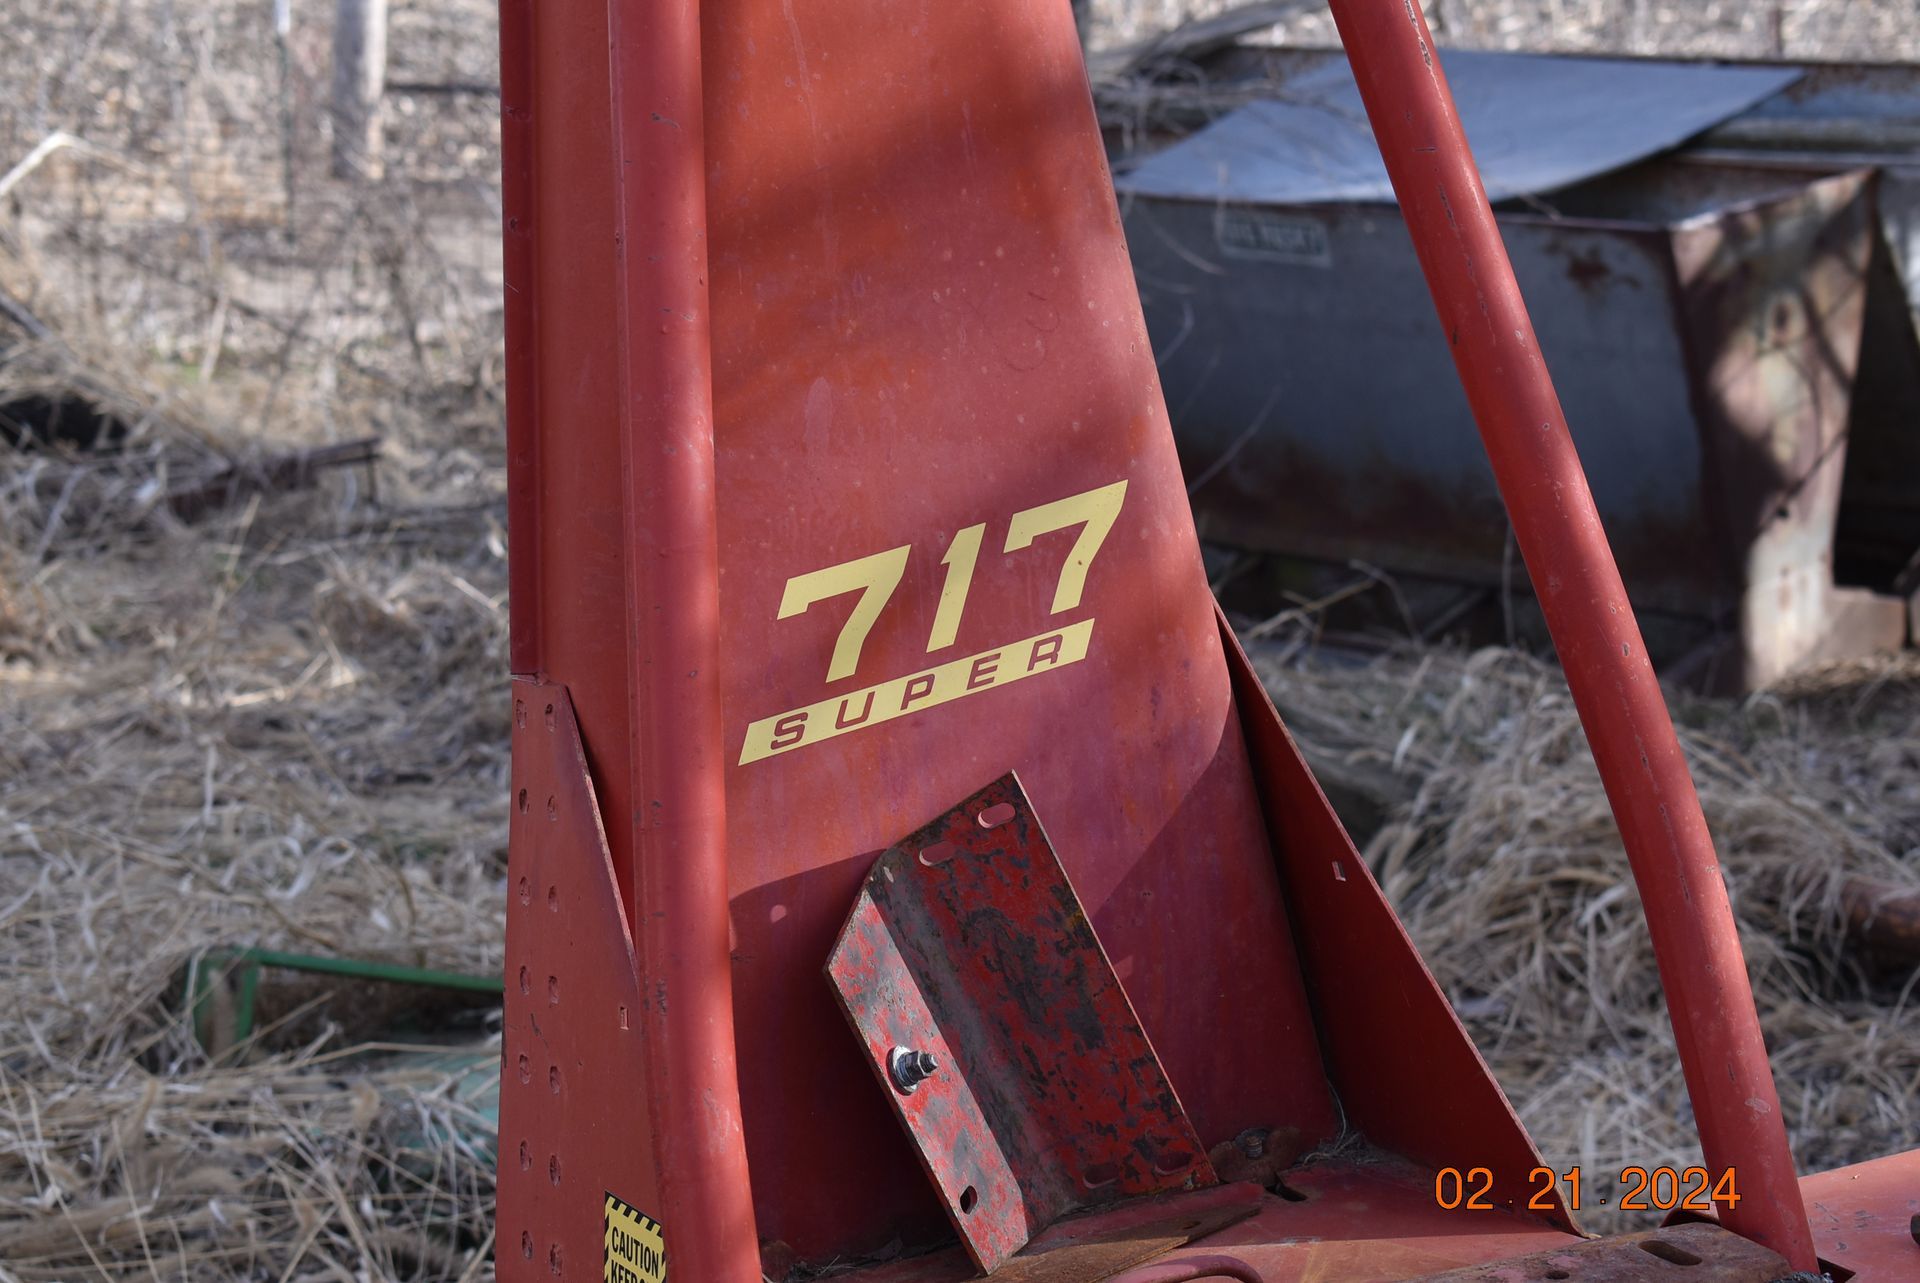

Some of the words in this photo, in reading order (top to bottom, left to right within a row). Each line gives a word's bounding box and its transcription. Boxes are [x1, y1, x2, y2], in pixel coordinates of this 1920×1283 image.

[776, 479, 1129, 683] 717
[769, 633, 1064, 750] SUPER
[611, 1226, 659, 1279] CAUTION
